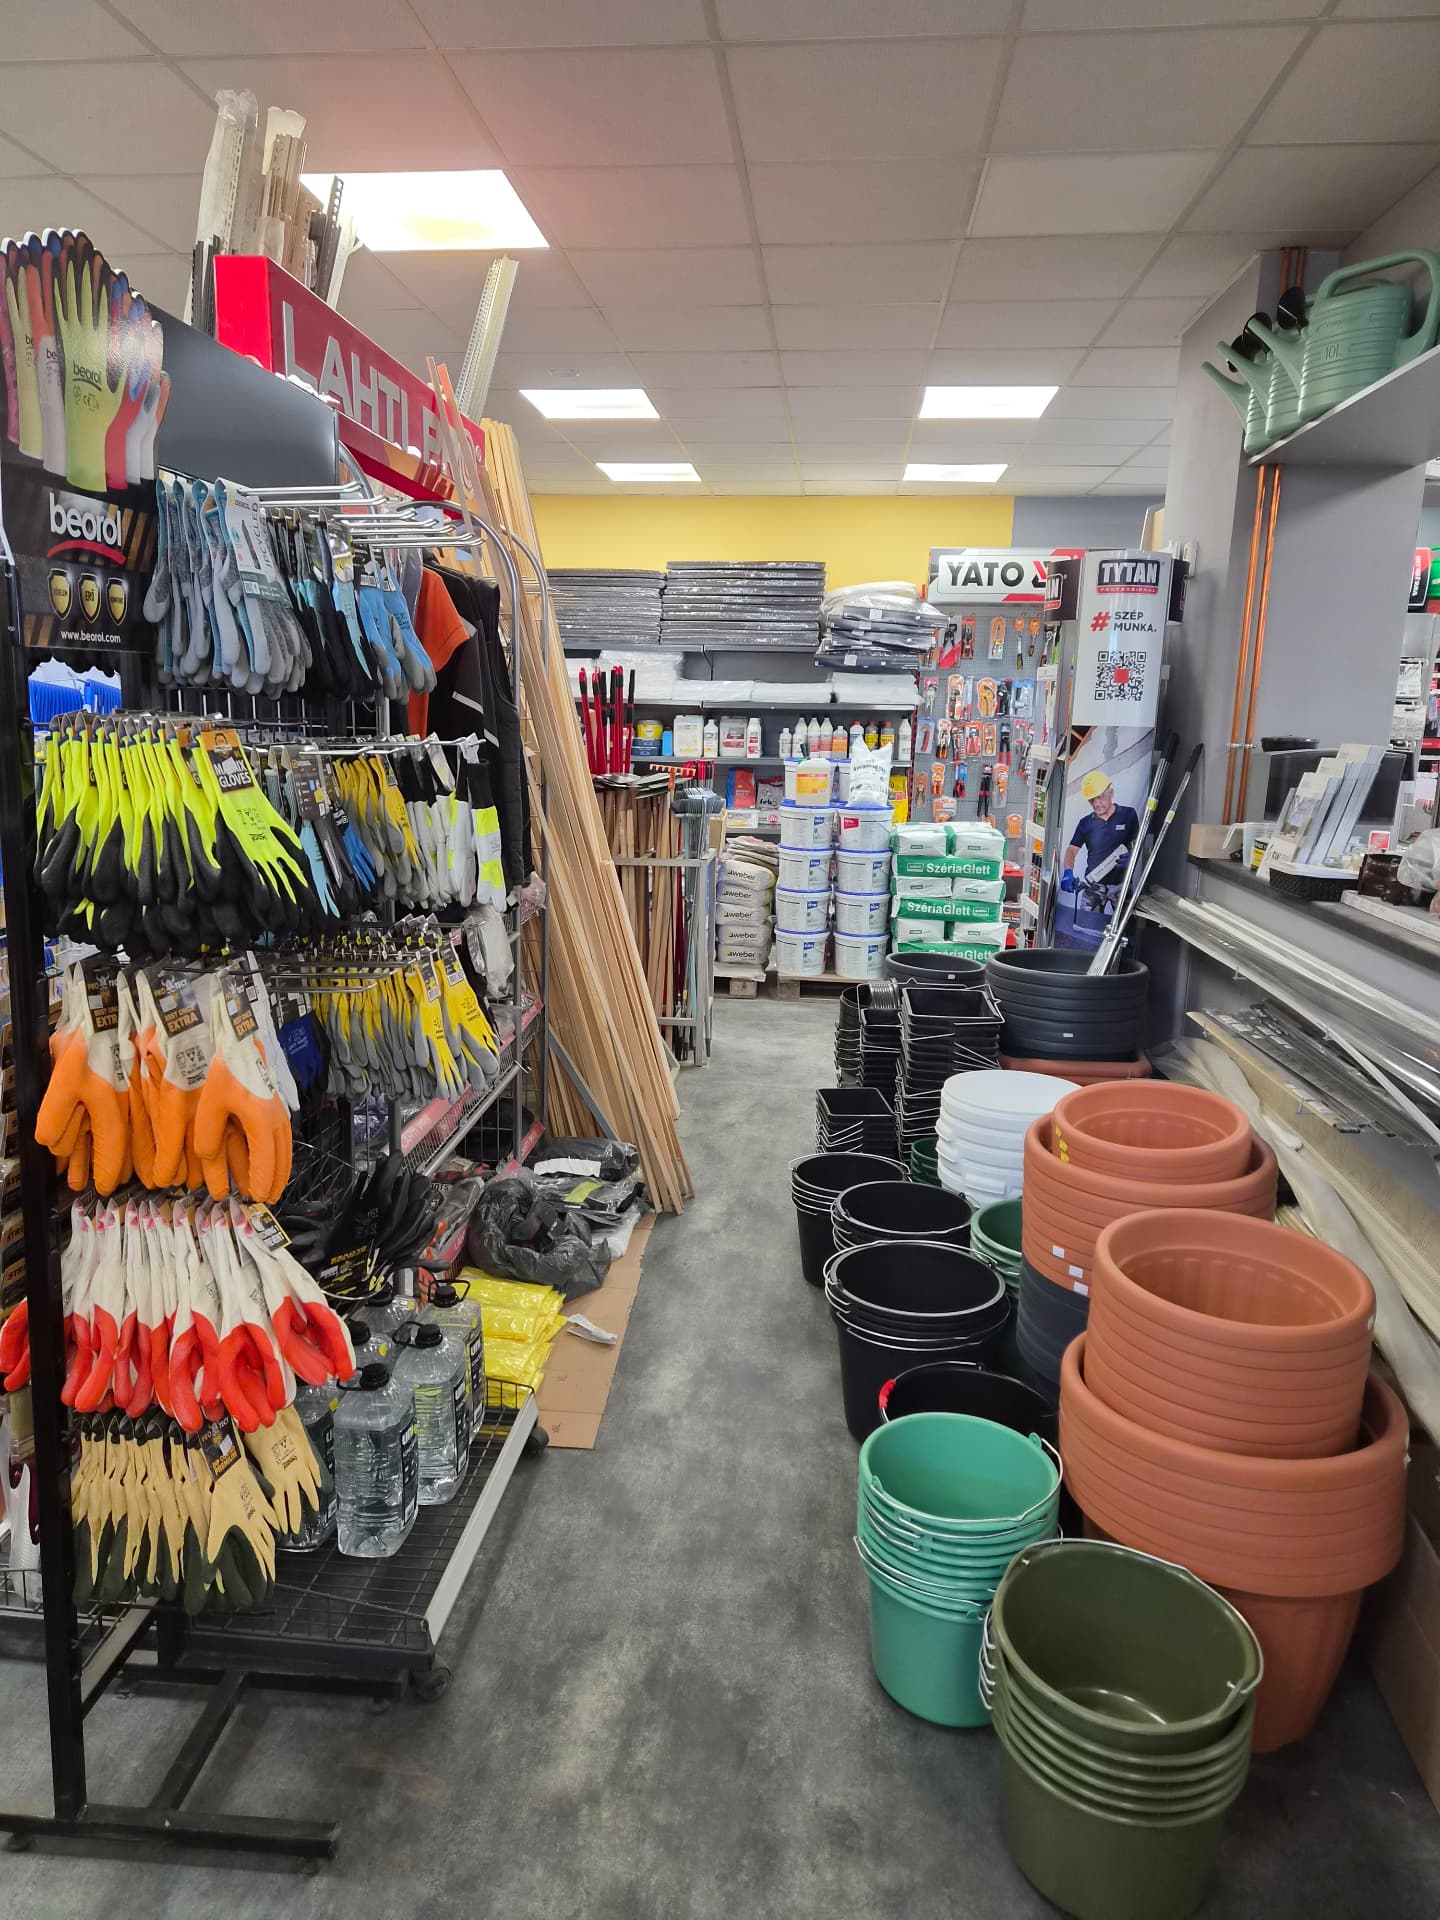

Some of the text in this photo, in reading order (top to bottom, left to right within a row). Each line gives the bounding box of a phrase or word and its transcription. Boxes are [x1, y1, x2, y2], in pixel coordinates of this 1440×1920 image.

[72, 360, 102, 385] beorol
[283, 301, 409, 452] LAHTI
[49, 491, 122, 547] beorol
[946, 561, 1024, 587] YATO
[1101, 562, 1158, 584] TYTAN
[1114, 609, 1144, 620] SZÉP
[1113, 622, 1157, 633] MUNKA.
[60, 629, 121, 644] www.beorol.com
[219, 772, 252, 788] GLOVES
[732, 871, 755, 881] weber
[926, 863, 991, 875] SzériaGlett
[728, 891, 751, 899] weber
[907, 902, 970, 916] SzériaGlett
[167, 1012, 199, 1033] EXTRA
[235, 1018, 257, 1036] EXTRA
